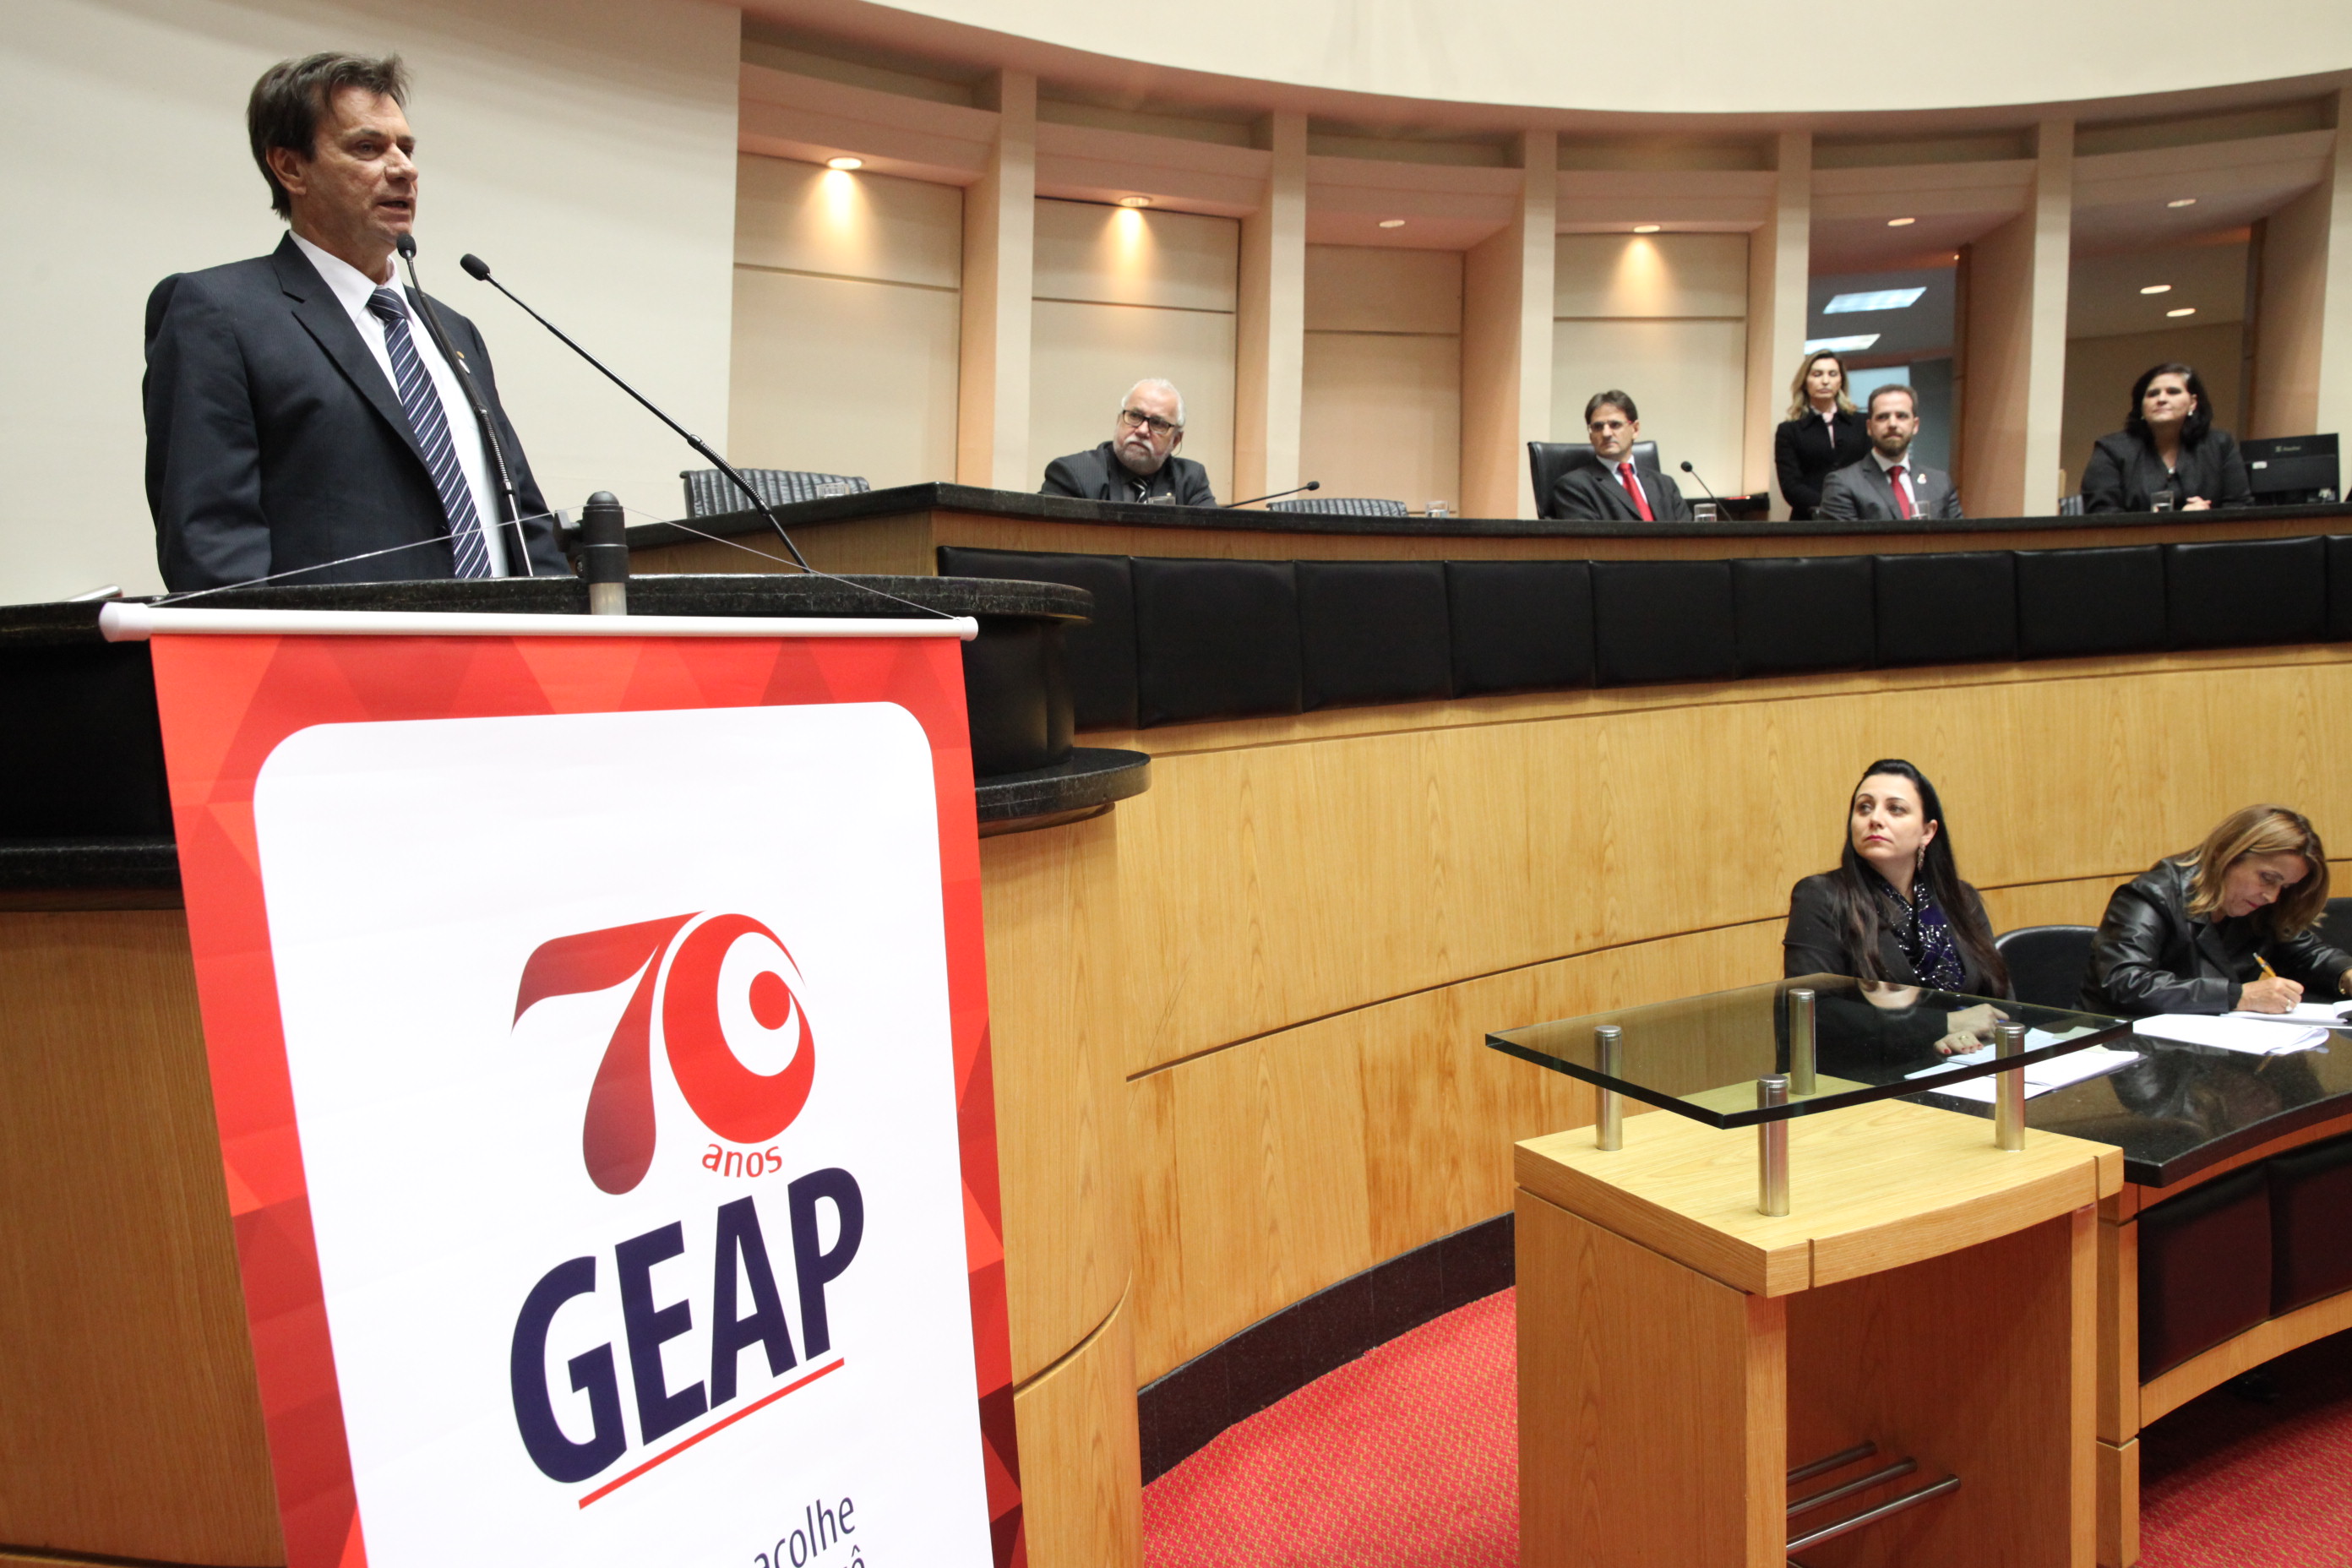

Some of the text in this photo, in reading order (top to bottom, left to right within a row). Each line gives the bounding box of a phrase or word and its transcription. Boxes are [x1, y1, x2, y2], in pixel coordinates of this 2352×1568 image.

[510, 910, 816, 1195] 70
[701, 1143, 783, 1179] anos
[509, 1167, 865, 1484] GEAP
